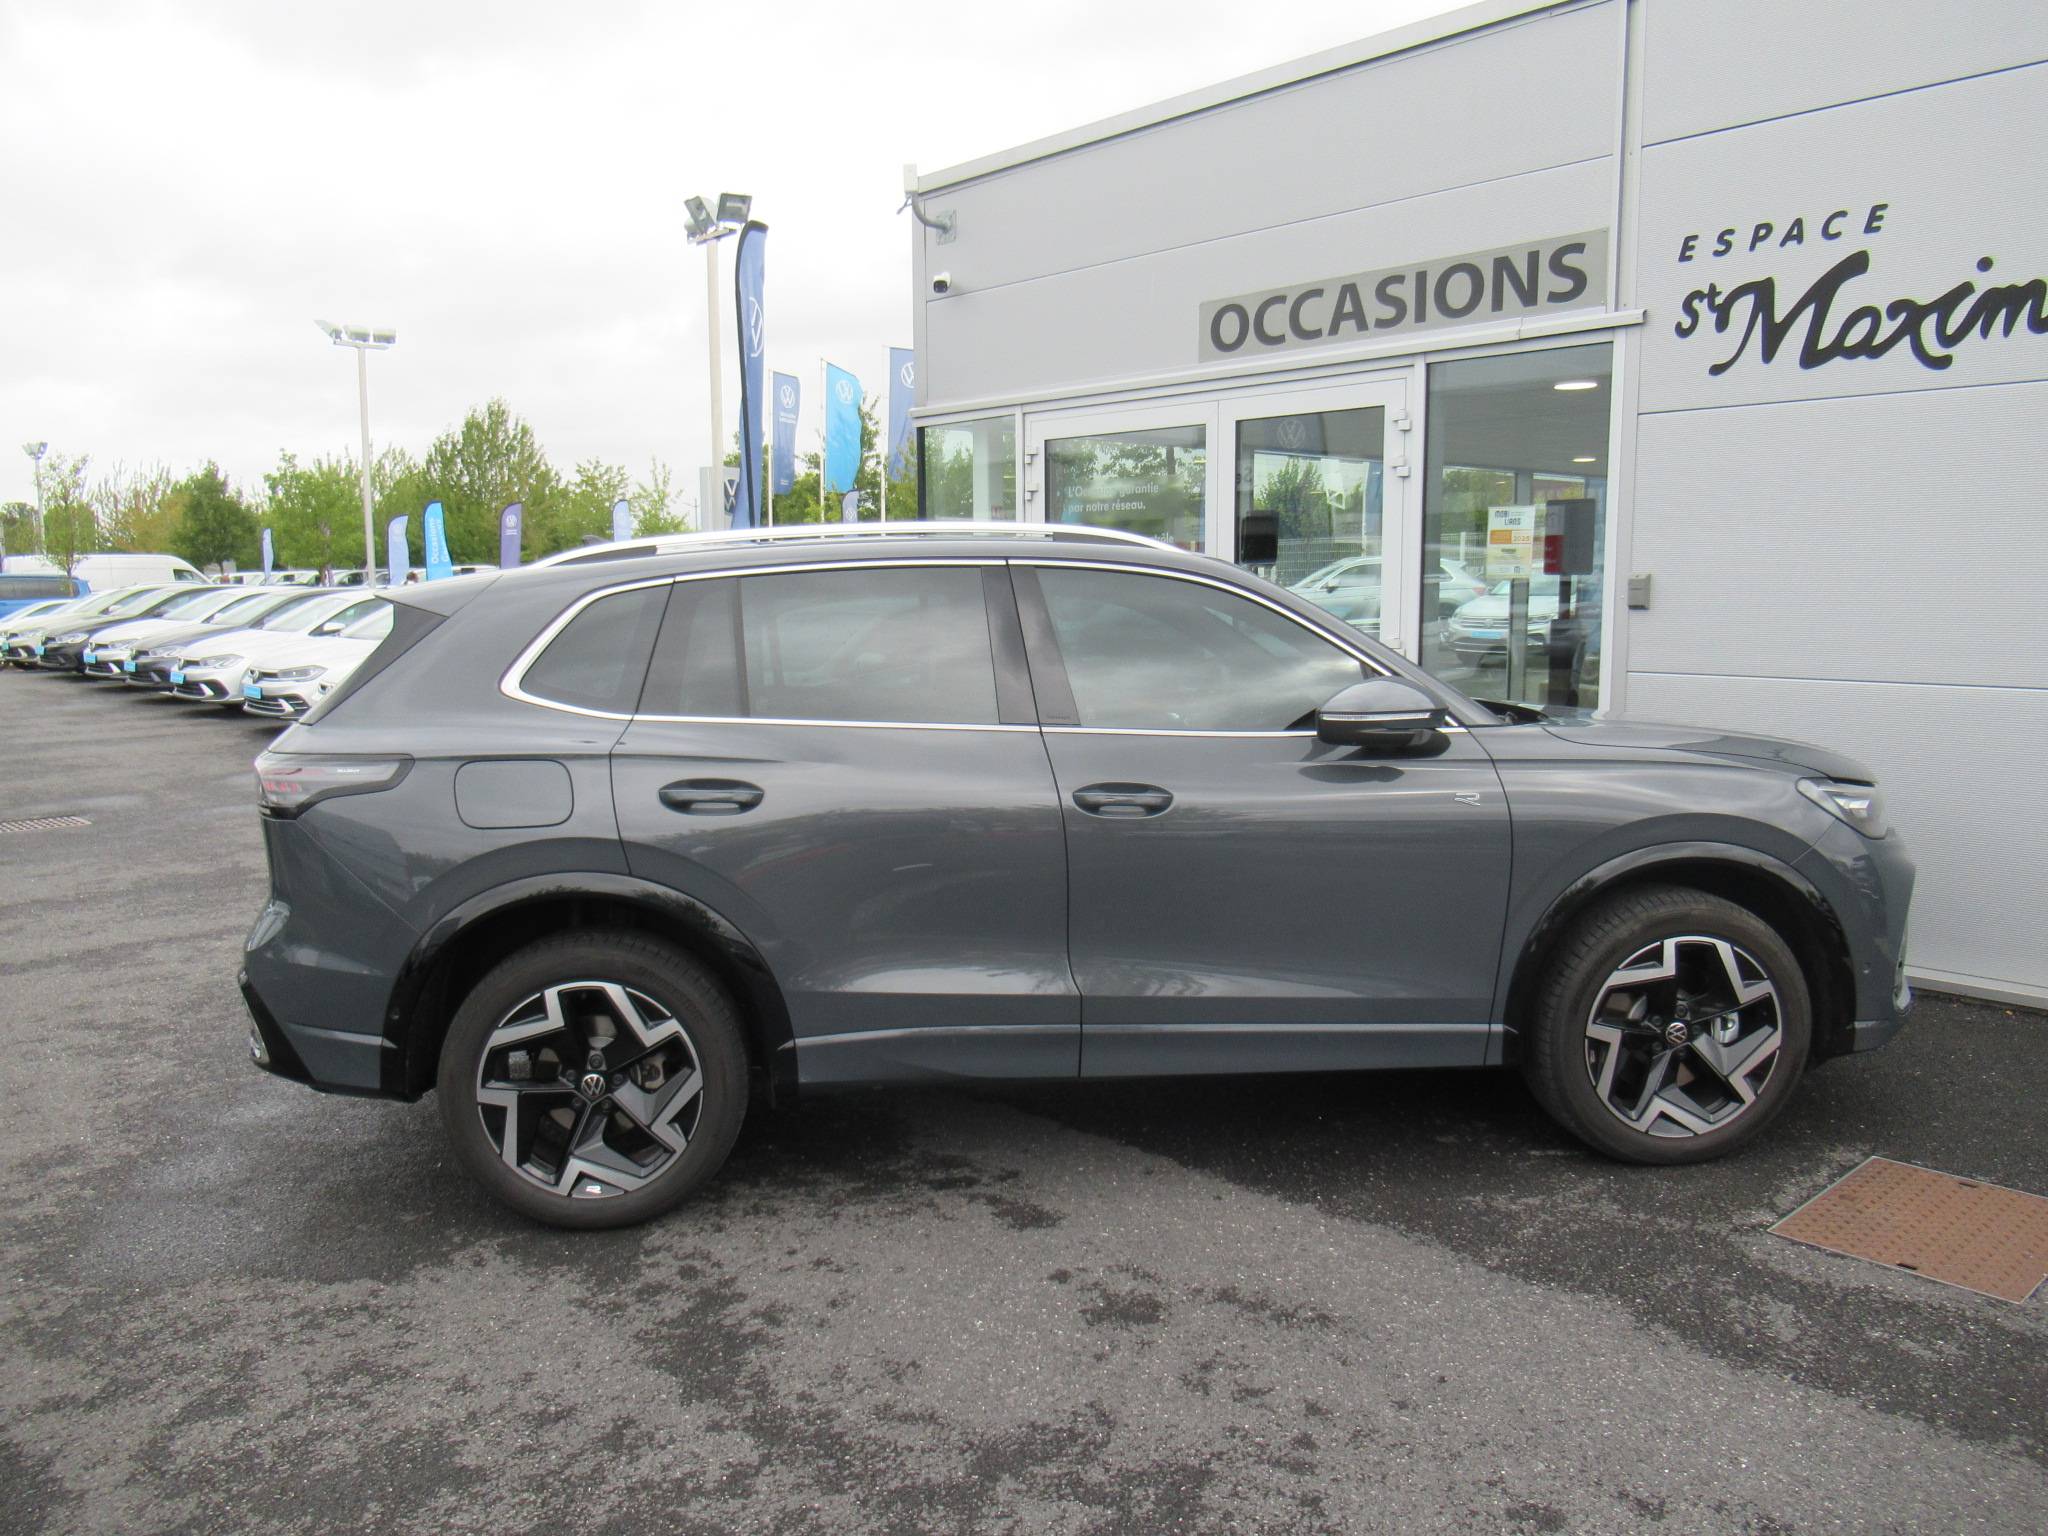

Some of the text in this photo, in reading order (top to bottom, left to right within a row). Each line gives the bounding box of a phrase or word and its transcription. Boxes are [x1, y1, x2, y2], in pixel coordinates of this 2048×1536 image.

[1677, 203, 1889, 263] ESPACE
[1209, 241, 1589, 354] OCCASIONS
[1086, 500, 1110, 514] notre
